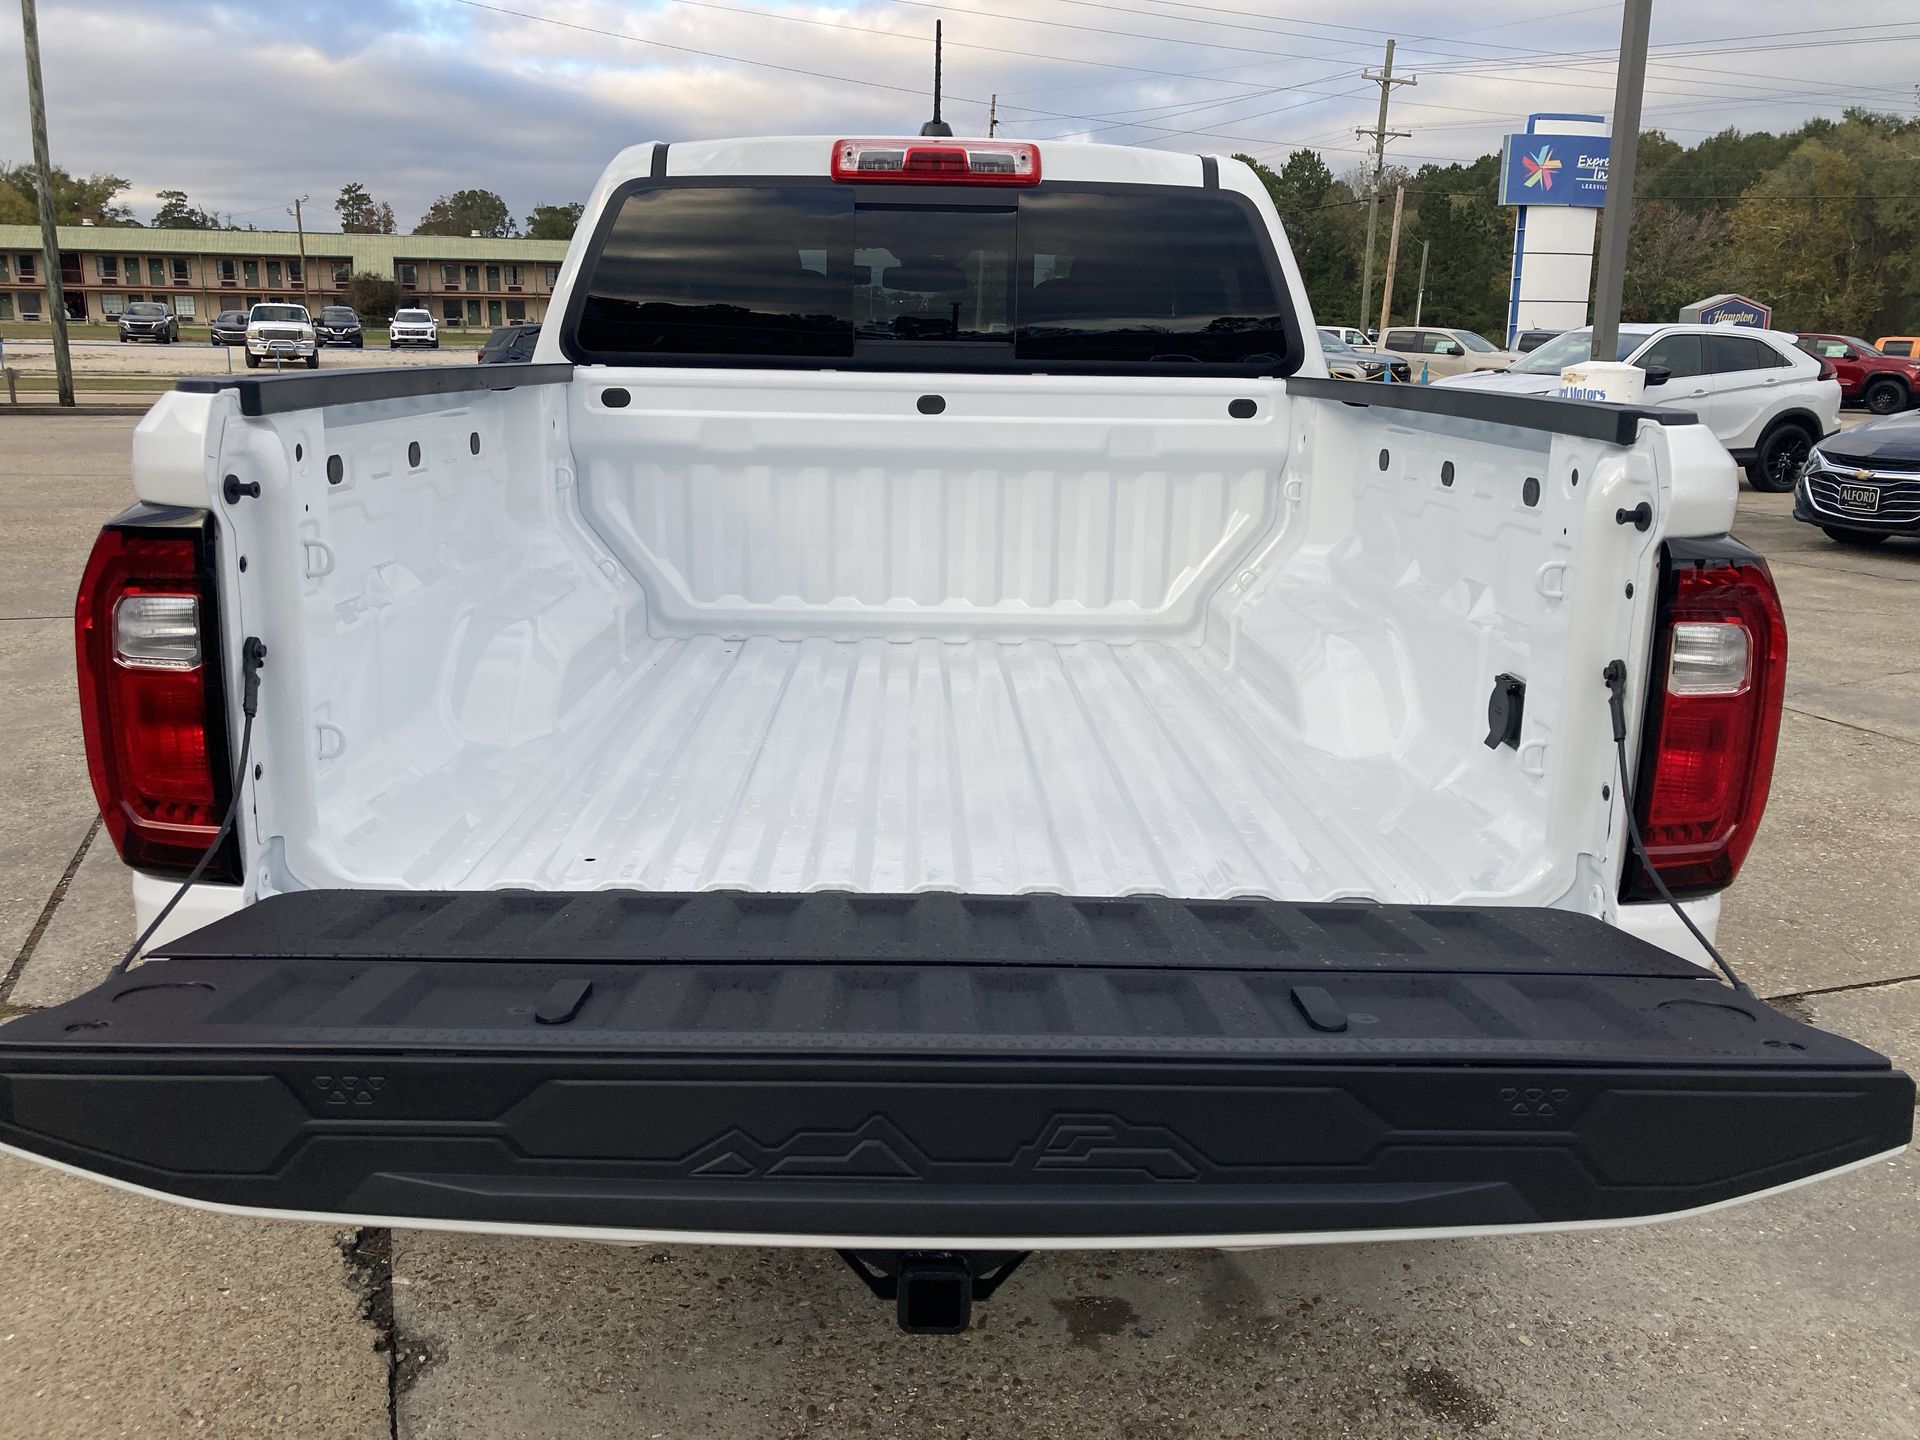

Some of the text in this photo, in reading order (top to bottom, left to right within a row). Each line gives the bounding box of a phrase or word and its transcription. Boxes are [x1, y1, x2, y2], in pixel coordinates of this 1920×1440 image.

[1711, 309, 1757, 325] Hampton
[1570, 386, 1607, 401] Motors
[1841, 489, 1876, 503] ALFORD
